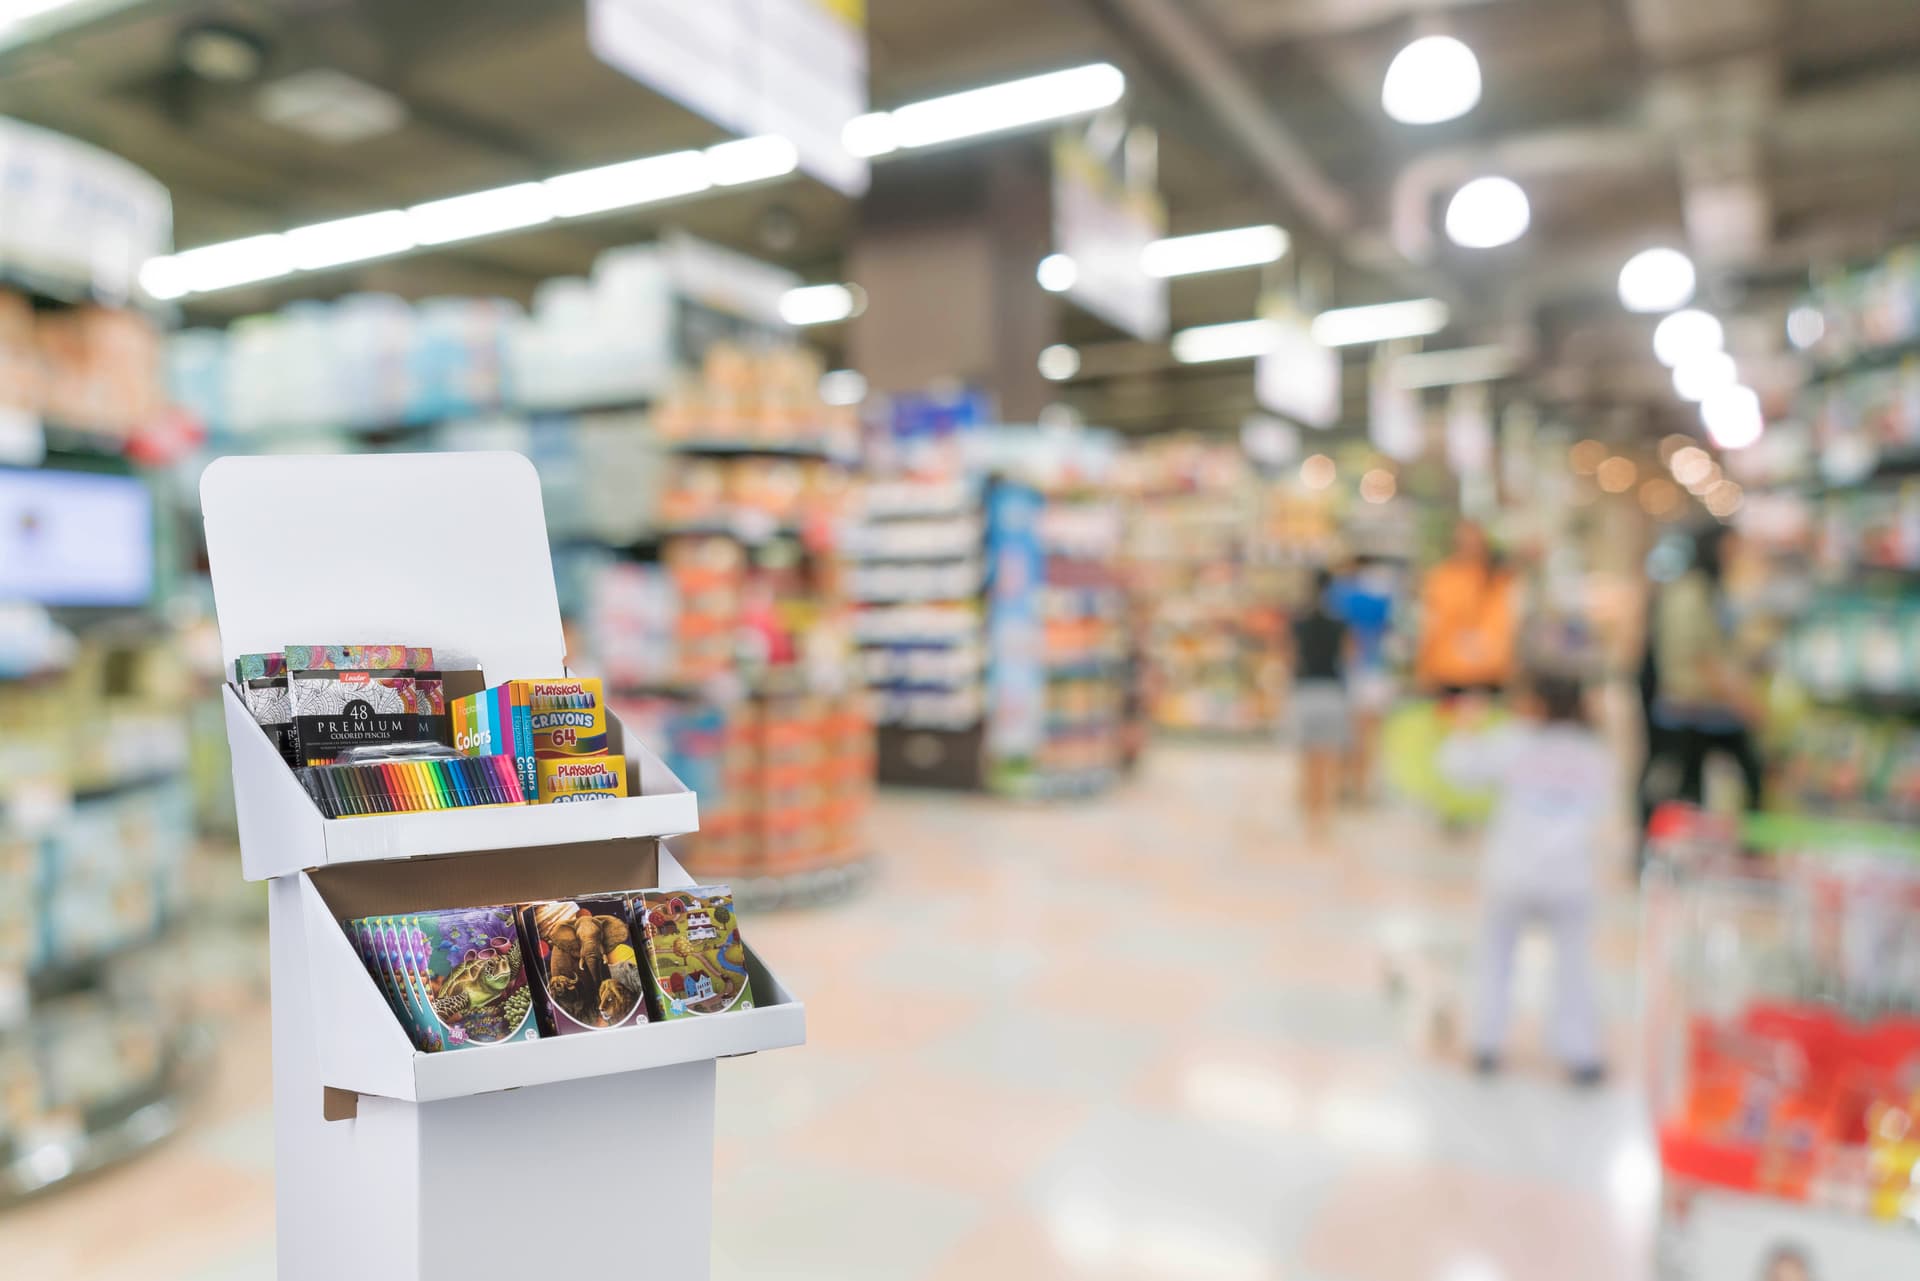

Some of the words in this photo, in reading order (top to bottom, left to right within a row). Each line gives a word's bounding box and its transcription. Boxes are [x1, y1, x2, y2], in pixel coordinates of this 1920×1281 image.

[534, 683, 585, 697] PLAYSKOOL
[350, 705, 369, 720] 48
[318, 720, 403, 733] PREMIUM
[532, 712, 594, 729] CRAYONS
[330, 732, 364, 740] COLORED
[364, 731, 391, 740] PENCILS
[456, 728, 492, 750] Colors
[552, 729, 577, 746] 64
[526, 756, 536, 791] Colors
[557, 764, 608, 778] PLAYSKOOL
